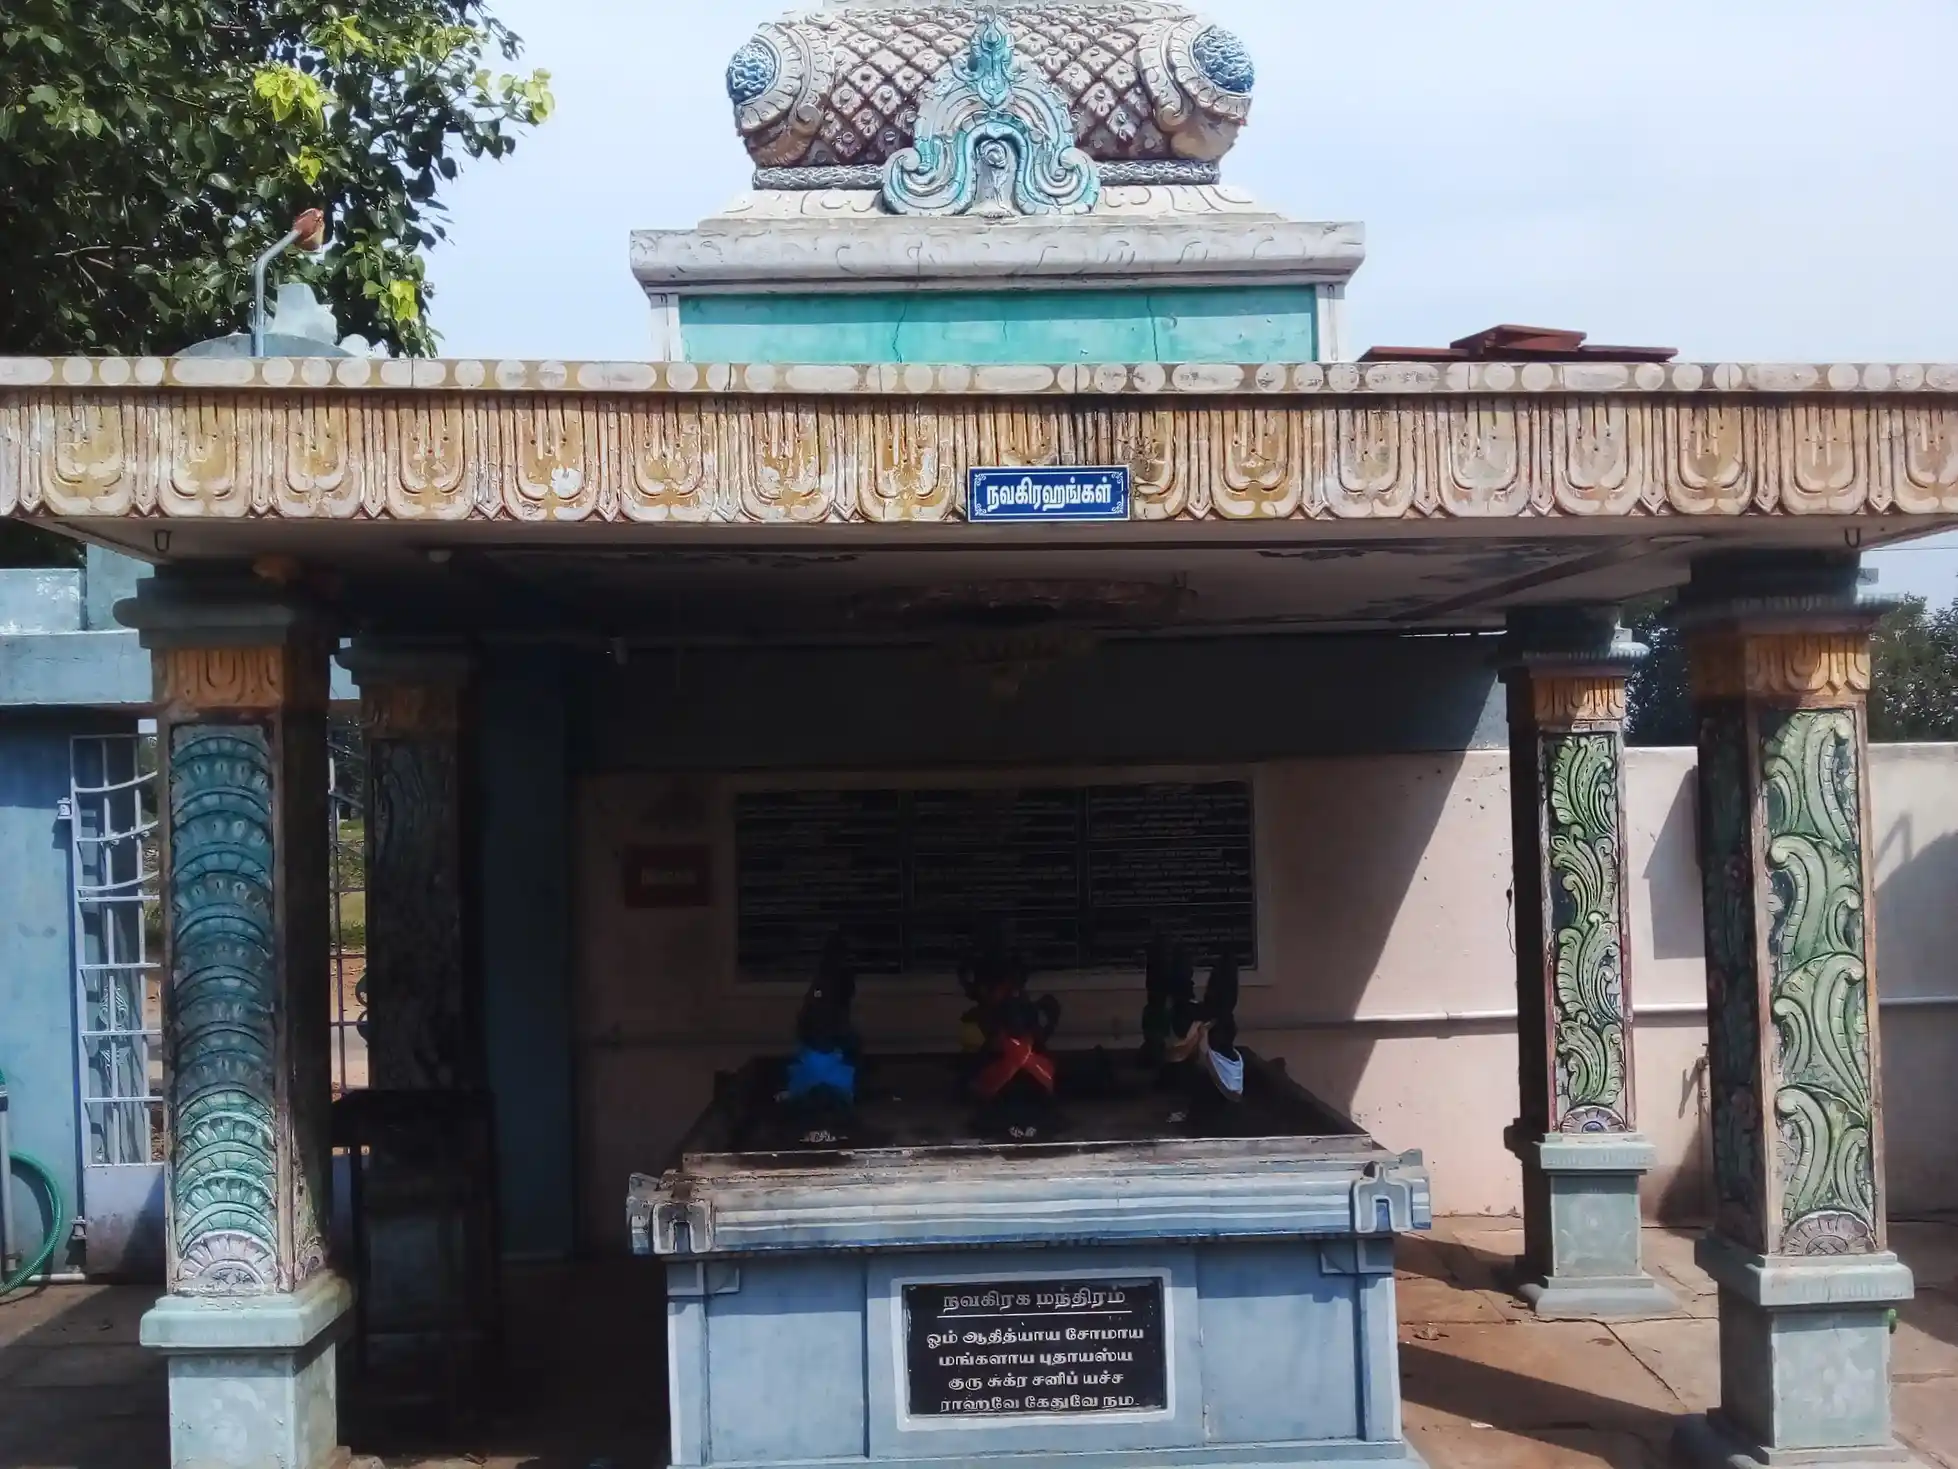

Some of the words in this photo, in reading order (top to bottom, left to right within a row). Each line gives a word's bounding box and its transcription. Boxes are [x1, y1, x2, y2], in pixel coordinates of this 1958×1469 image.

[986, 476, 1112, 512] நவகிரஹங்கள்
[943, 1290, 1031, 1313] நவகிரக
[1036, 1286, 1125, 1309] மந்திரம்
[963, 1327, 1060, 1346] ஆதித்யாய
[1065, 1327, 1144, 1341] சோமாய
[939, 1352, 1035, 1366] மங்களாய
[949, 1377, 983, 1391] குரு
[1025, 1394, 1099, 1411] கேதுவே
